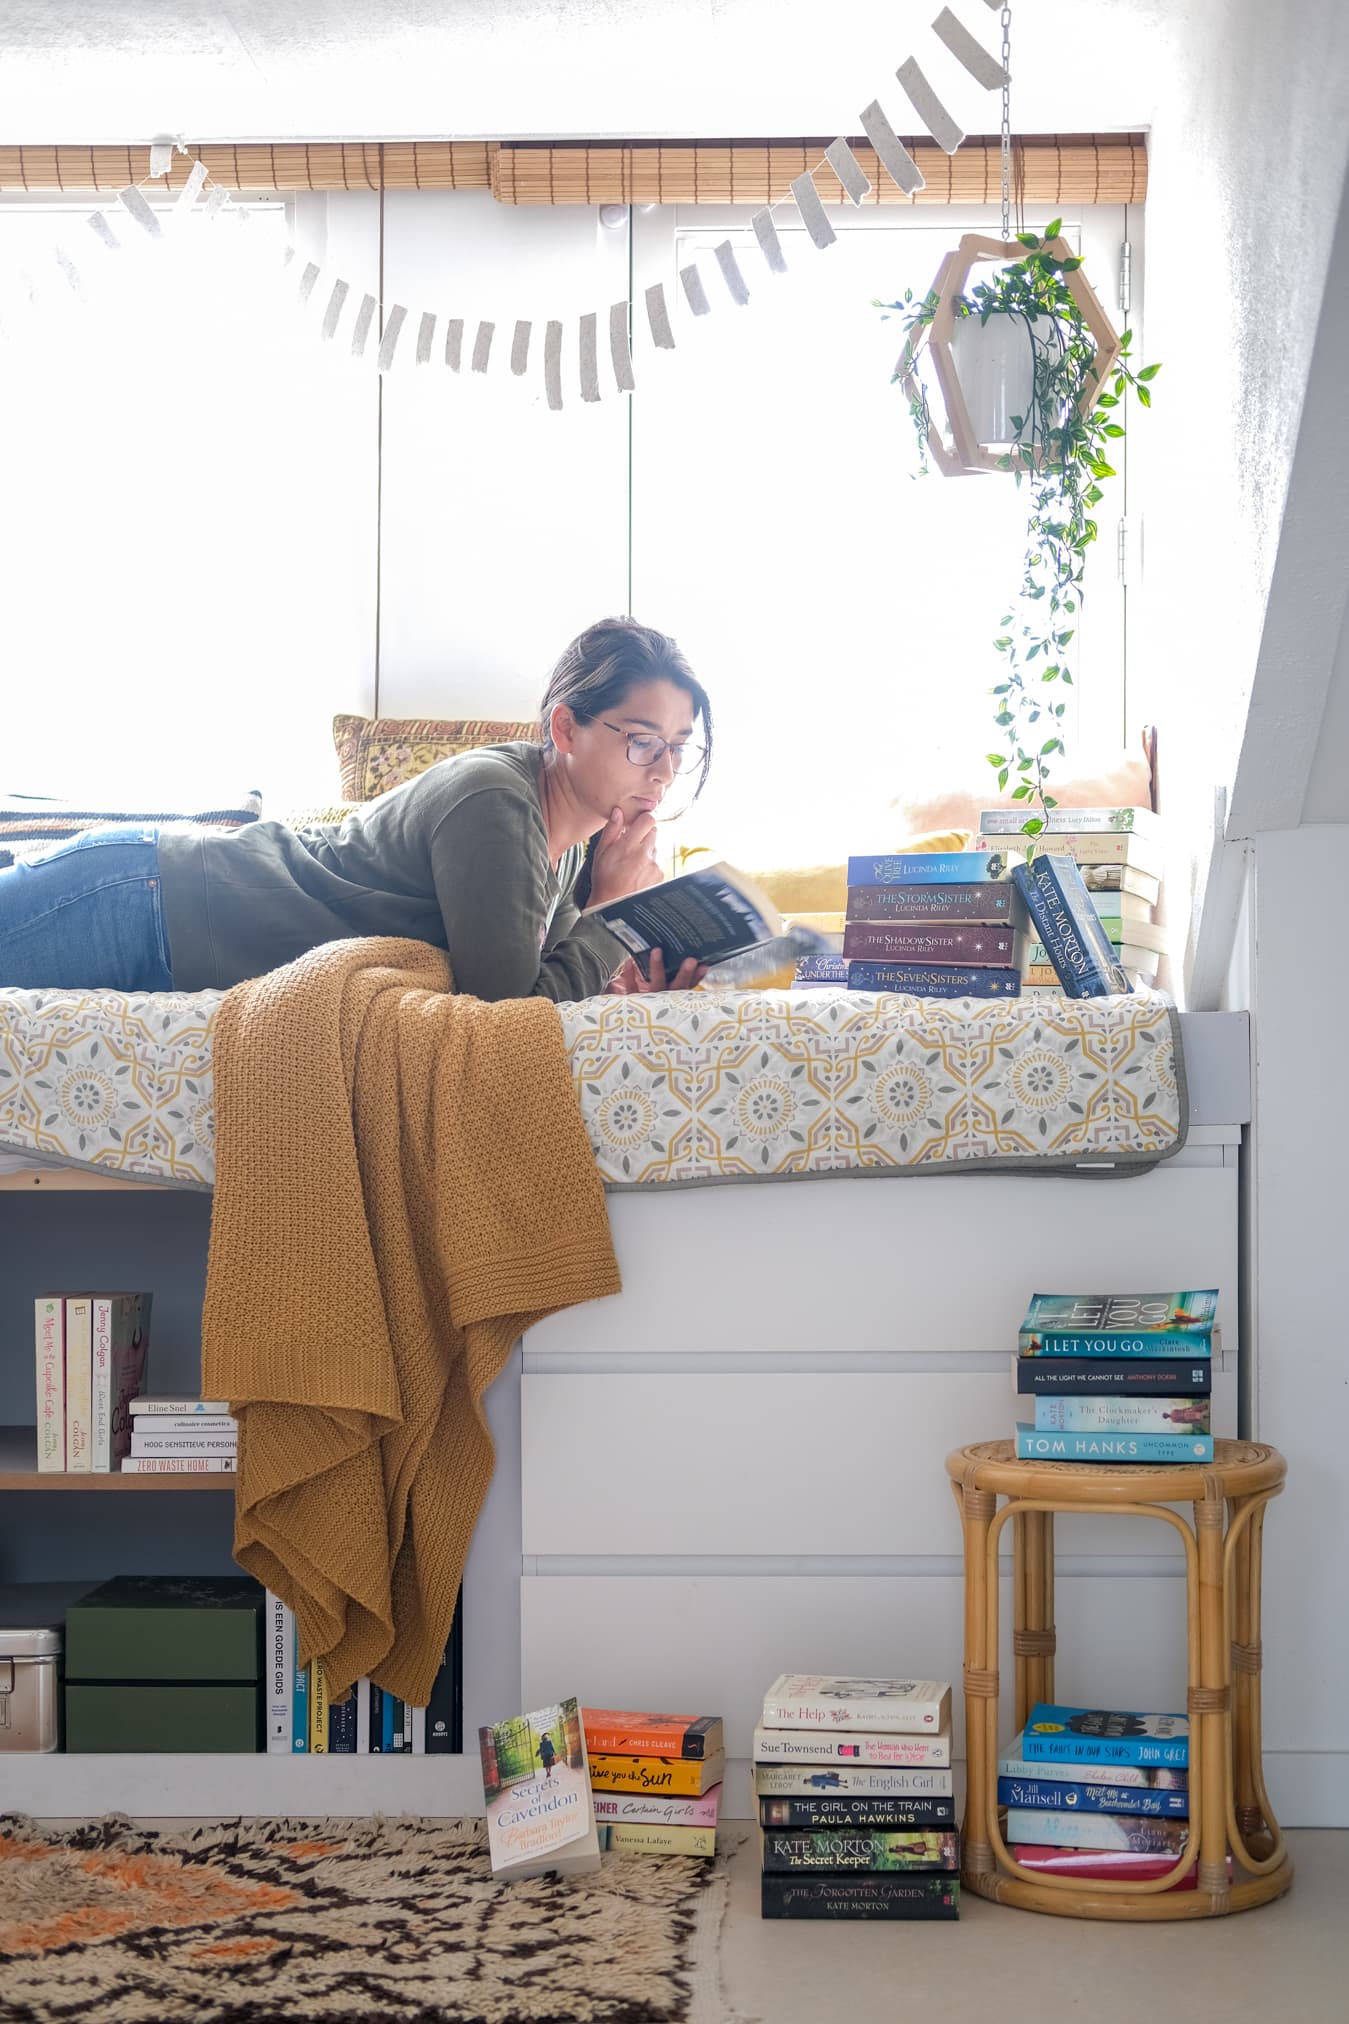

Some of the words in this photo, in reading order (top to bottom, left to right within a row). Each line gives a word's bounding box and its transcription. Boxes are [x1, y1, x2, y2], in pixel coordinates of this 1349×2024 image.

[1000, 816, 1017, 824] small
[1039, 844, 1065, 852] Howard
[903, 864, 937, 875] LUCINDA
[877, 893, 896, 904] THE
[896, 891, 937, 905] STORM
[937, 893, 972, 905] SISTER
[895, 903, 929, 912] LUCINDA
[1036, 871, 1061, 909] KATE
[1052, 911, 1088, 974] MORTON
[866, 935, 885, 945] THE
[885, 935, 927, 946] SHADOW
[926, 936, 954, 946] SISTER
[1035, 902, 1055, 938] Distant
[1050, 936, 1067, 969] Hours
[885, 944, 916, 952] LUCINDA
[804, 970, 831, 978] UNDER
[832, 970, 845, 978] THE
[876, 971, 896, 982] THE
[896, 971, 933, 985] SEVEN
[932, 973, 969, 985] SISTERS
[895, 984, 928, 993] LUCINDA
[928, 985, 947, 993] RILEY
[97, 1306, 109, 1333] Jenny
[1067, 1302, 1103, 1327] LET
[1104, 1299, 1141, 1329] YOU
[1138, 1302, 1169, 1325] GO
[97, 1335, 109, 1368] Colgan
[1045, 1339, 1049, 1352] I
[1053, 1339, 1080, 1352] LET
[1084, 1339, 1118, 1352] YOU
[1120, 1339, 1144, 1352] GO
[148, 1403, 168, 1413] Eline
[169, 1403, 187, 1413] Snel
[1080, 1406, 1096, 1414] The
[1098, 1415, 1140, 1426] Daughter
[165, 1441, 206, 1449] SENSITIEVE
[1026, 1439, 1066, 1453] TOM
[1075, 1441, 1137, 1455] HANKS
[137, 1459, 157, 1472] ZERO
[159, 1459, 185, 1472] WASTE
[187, 1459, 209, 1472] HOME
[275, 1601, 284, 1611] IS
[275, 1612, 284, 1633] EEN
[275, 1635, 284, 1669] GOEDE
[275, 1671, 284, 1696] GIDS
[777, 1703, 795, 1719] The
[798, 1707, 826, 1723] Help
[629, 1739, 650, 1747] CHRIS
[651, 1740, 676, 1749] CLEAVE
[760, 1742, 780, 1754] Sue
[780, 1742, 833, 1755] Townsend
[1028, 1743, 1043, 1753] THE
[1075, 1745, 1085, 1755] IN
[1104, 1745, 1130, 1758] STARS
[1138, 1746, 1161, 1760] JOHN
[1005, 1763, 1034, 1776] Libby
[611, 1770, 627, 1784] you
[640, 1768, 673, 1787] Sun
[762, 1773, 801, 1781] MARGARET
[852, 1776, 867, 1786] The
[869, 1775, 909, 1790] English
[912, 1775, 934, 1789] Girl
[511, 1778, 560, 1801] Secrets
[1026, 1784, 1039, 1794] Jill
[1085, 1786, 1105, 1800] Meet
[531, 1793, 541, 1804] of
[1010, 1789, 1061, 1806] Mansell
[497, 1792, 578, 1828] Cavendon
[794, 1803, 816, 1813] THE
[821, 1802, 848, 1812] GIRL
[851, 1802, 868, 1812] ON
[872, 1802, 895, 1812] THE
[898, 1801, 932, 1811] TRAIN
[1141, 1798, 1162, 1811] Bay
[622, 1803, 661, 1815] Certain
[663, 1805, 696, 1822] Girls
[812, 1814, 852, 1824] PAULA
[859, 1814, 915, 1823] HAWKINS
[615, 1834, 644, 1844] Vanessa
[647, 1836, 672, 1846] Lafaye
[774, 1840, 810, 1855] KATE
[817, 1839, 885, 1857] MORTON
[803, 1854, 835, 1865] Secret
[836, 1854, 871, 1868] Keeper
[791, 1889, 809, 1897] THE
[810, 1883, 878, 1898] FORGOTTEN
[880, 1885, 925, 1899] GARDEN
[827, 1902, 849, 1911] KATE
[850, 1902, 889, 1911] MORTON
